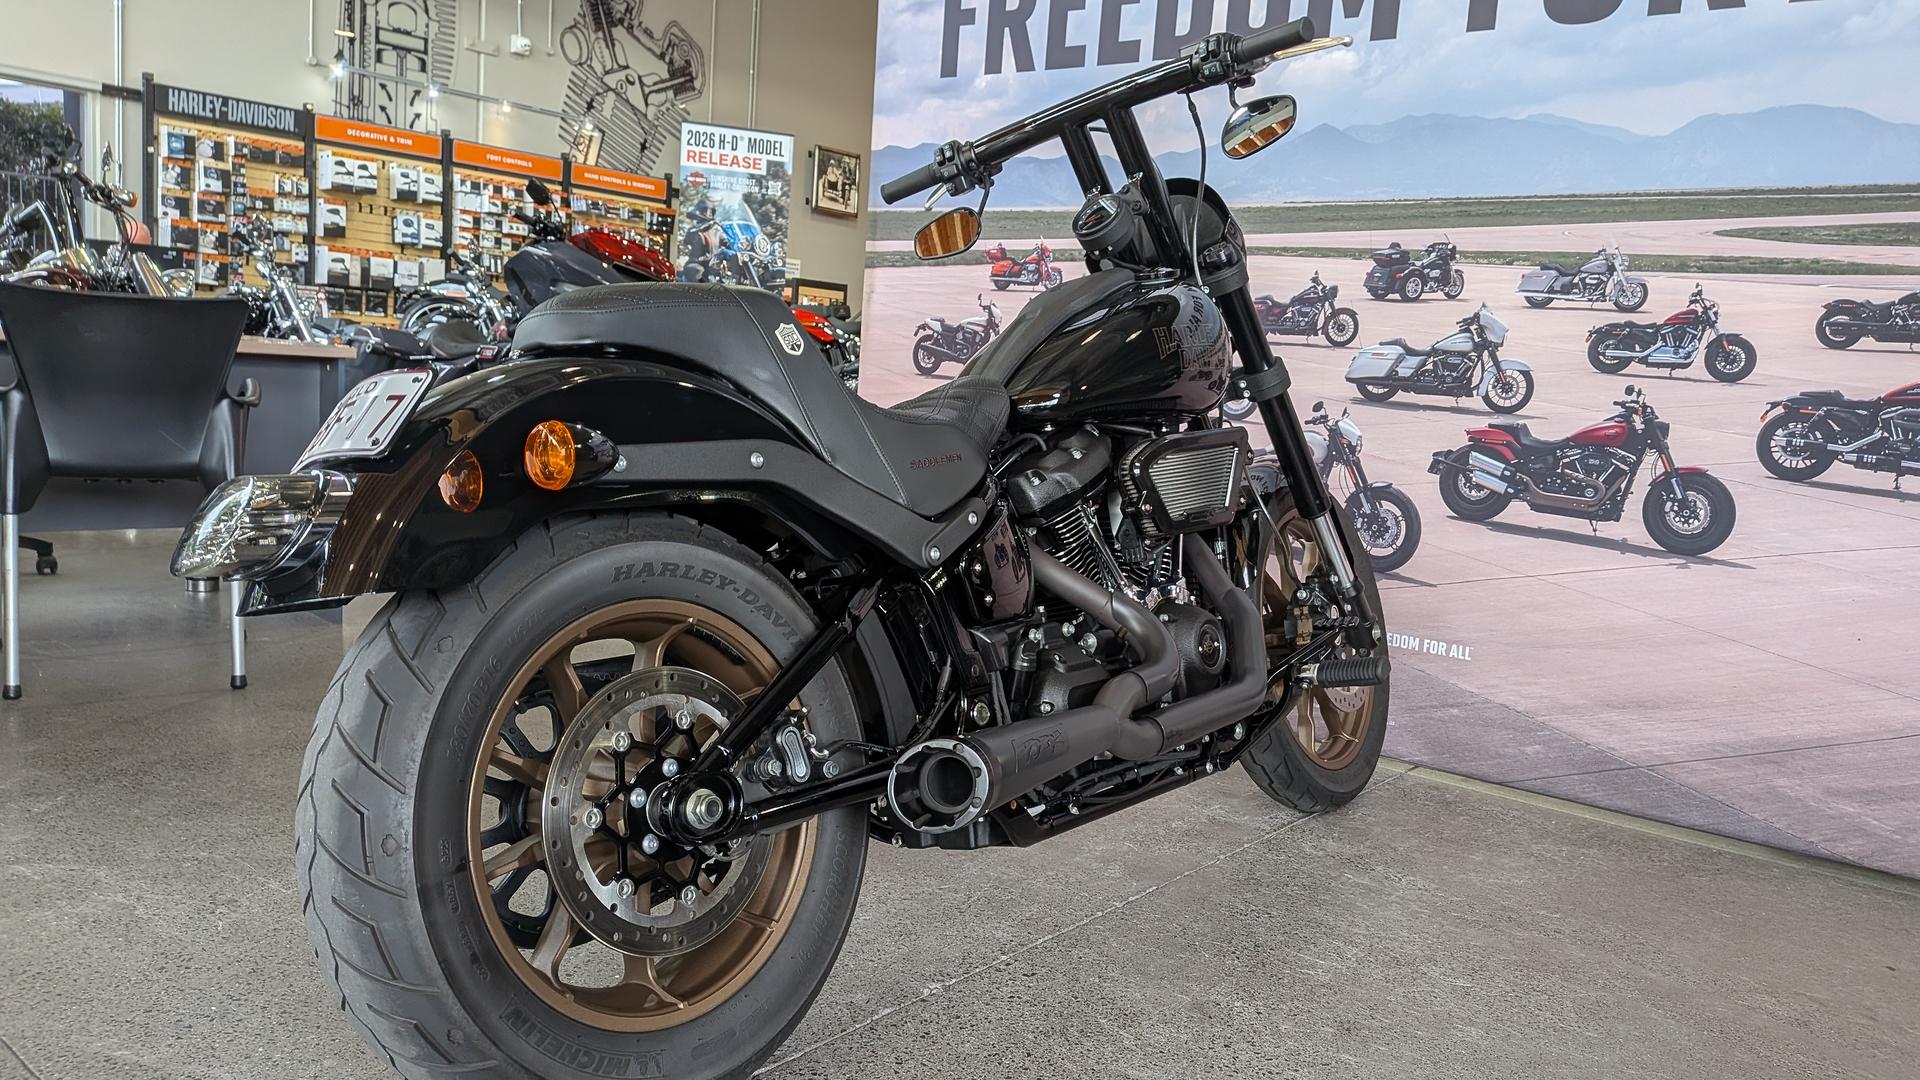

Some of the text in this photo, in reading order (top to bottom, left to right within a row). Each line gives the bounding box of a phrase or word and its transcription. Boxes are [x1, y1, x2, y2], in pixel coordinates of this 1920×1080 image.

[168, 88, 296, 132] HARLEY-DAVIDSON
[347, 128, 413, 146] DECORATIVE & TRIM
[687, 129, 716, 149] 2026
[747, 137, 785, 157] MODEL
[486, 153, 533, 169] FOOT CONTROLS
[686, 149, 762, 171] RELEASE
[584, 172, 599, 181] HAND
[600, 174, 627, 186] CONTROLS
[1152, 325, 1216, 360] HARLE
[611, 562, 800, 646] HARLEY-DAVI
[1386, 632, 1472, 661] EDOM FOR ALL
[505, 1006, 631, 1076] MICHELIN
